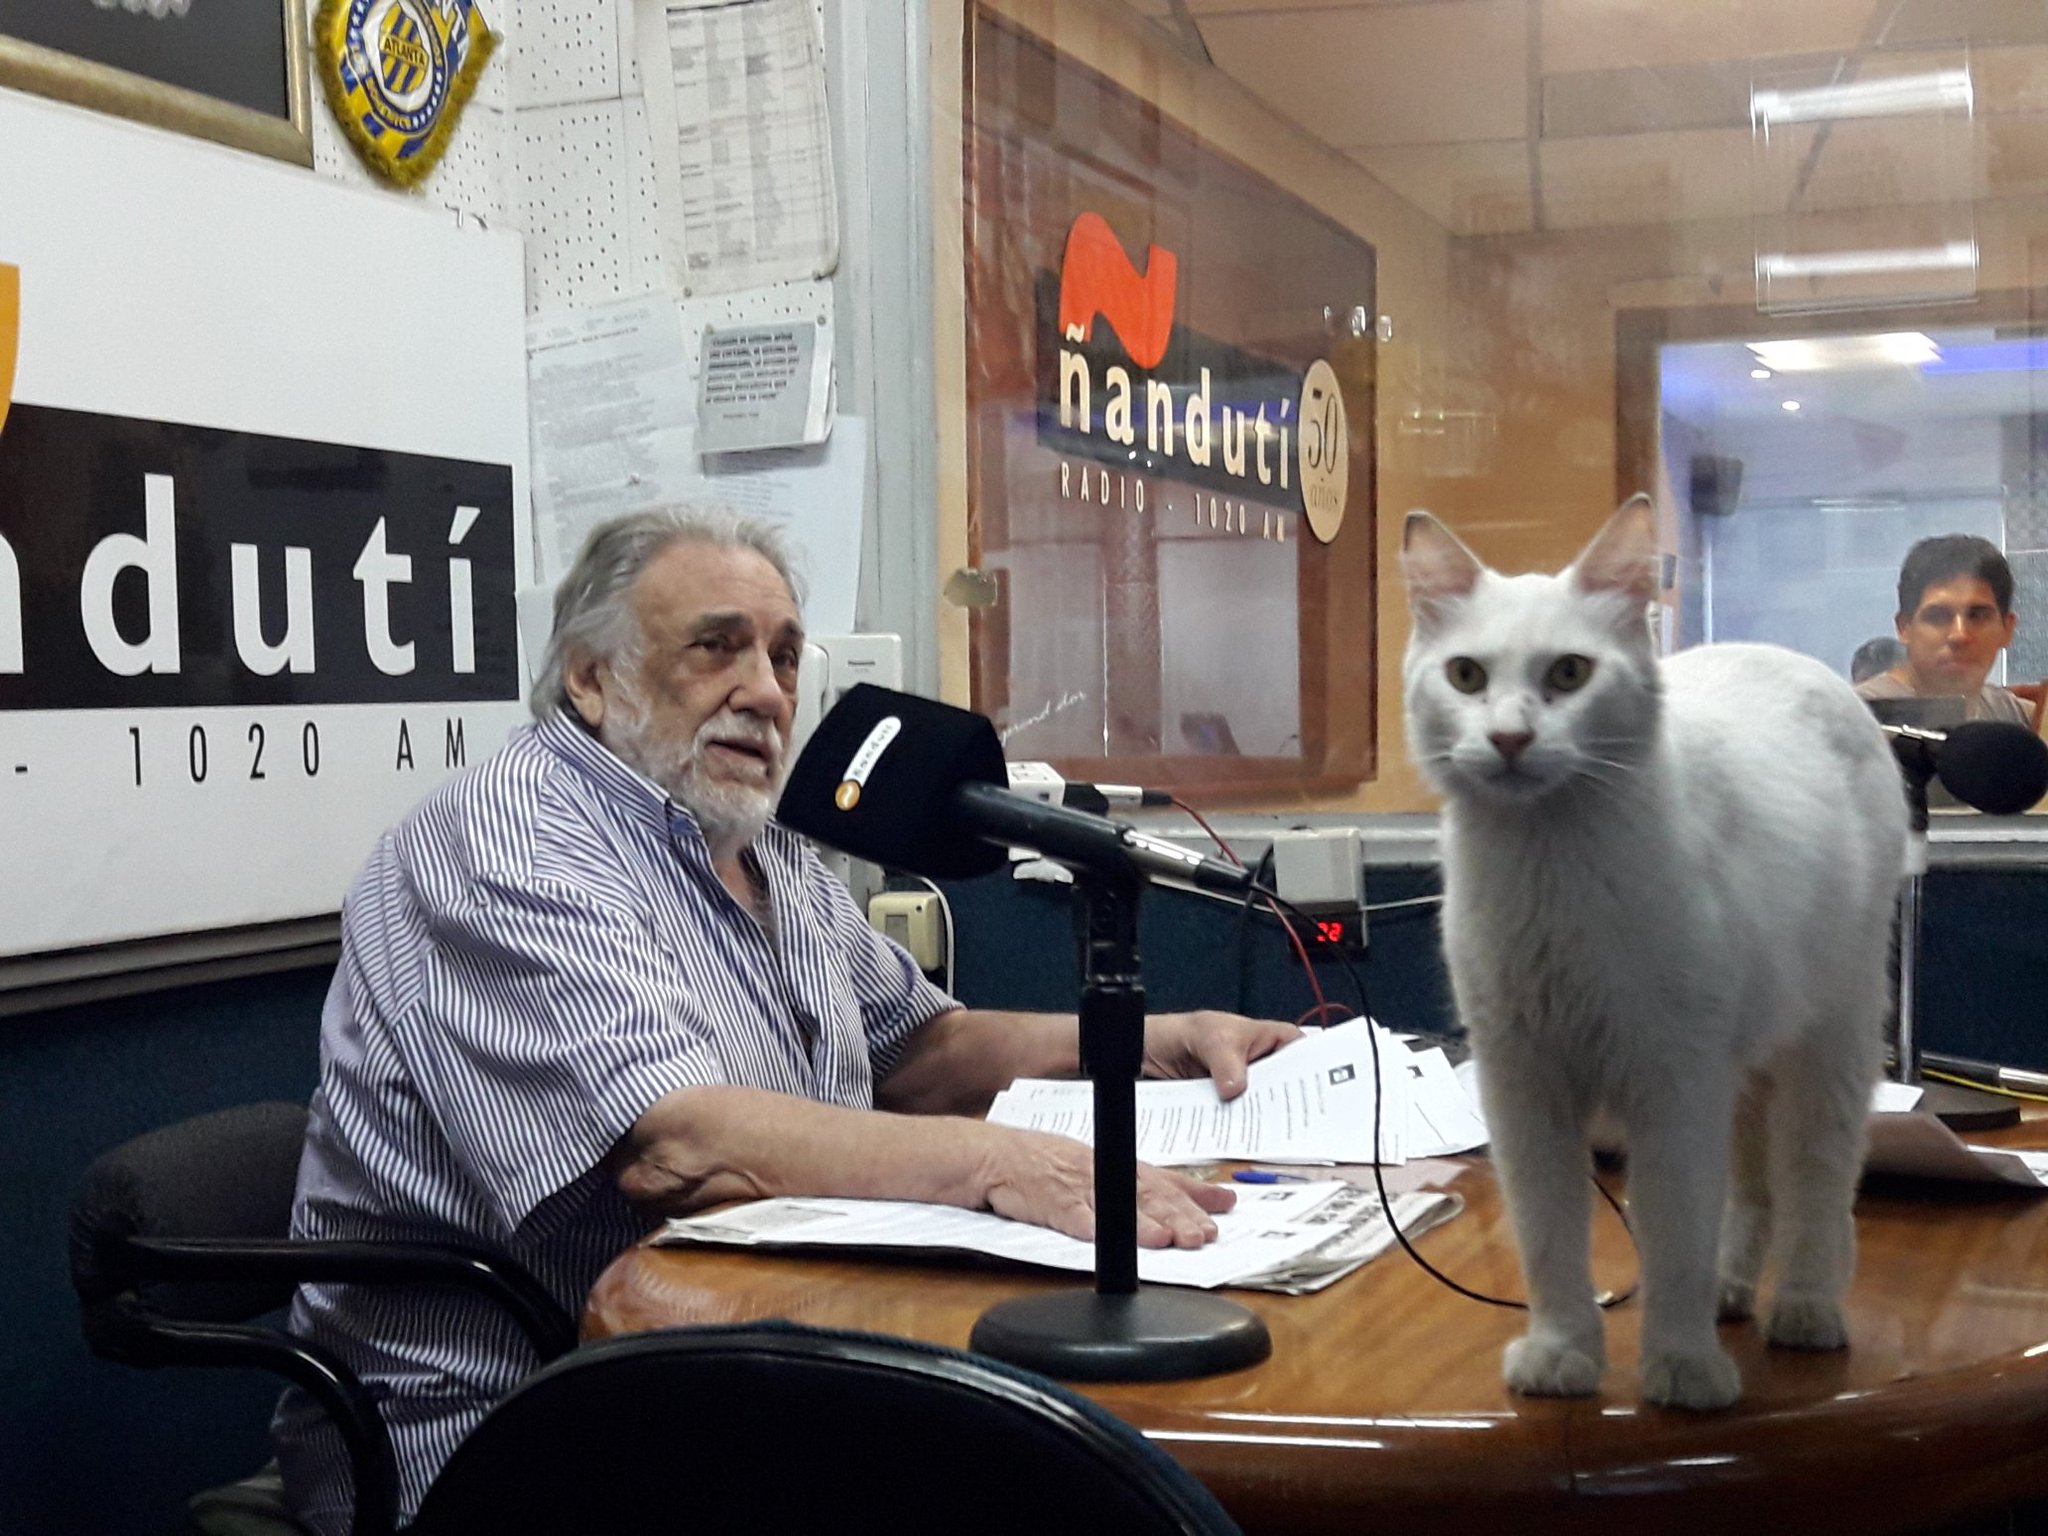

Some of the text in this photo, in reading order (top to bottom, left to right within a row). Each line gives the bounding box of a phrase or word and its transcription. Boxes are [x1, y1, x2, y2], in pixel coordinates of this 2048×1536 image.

[1059, 322, 1290, 490] ñandutí
[1307, 387, 1339, 475] 50
[1061, 460, 1145, 513] RADIO
[1195, 492, 1246, 535] 1020
[0, 473, 481, 677] dutí
[129, 719, 321, 787] 1020
[396, 718, 466, 771] AM
